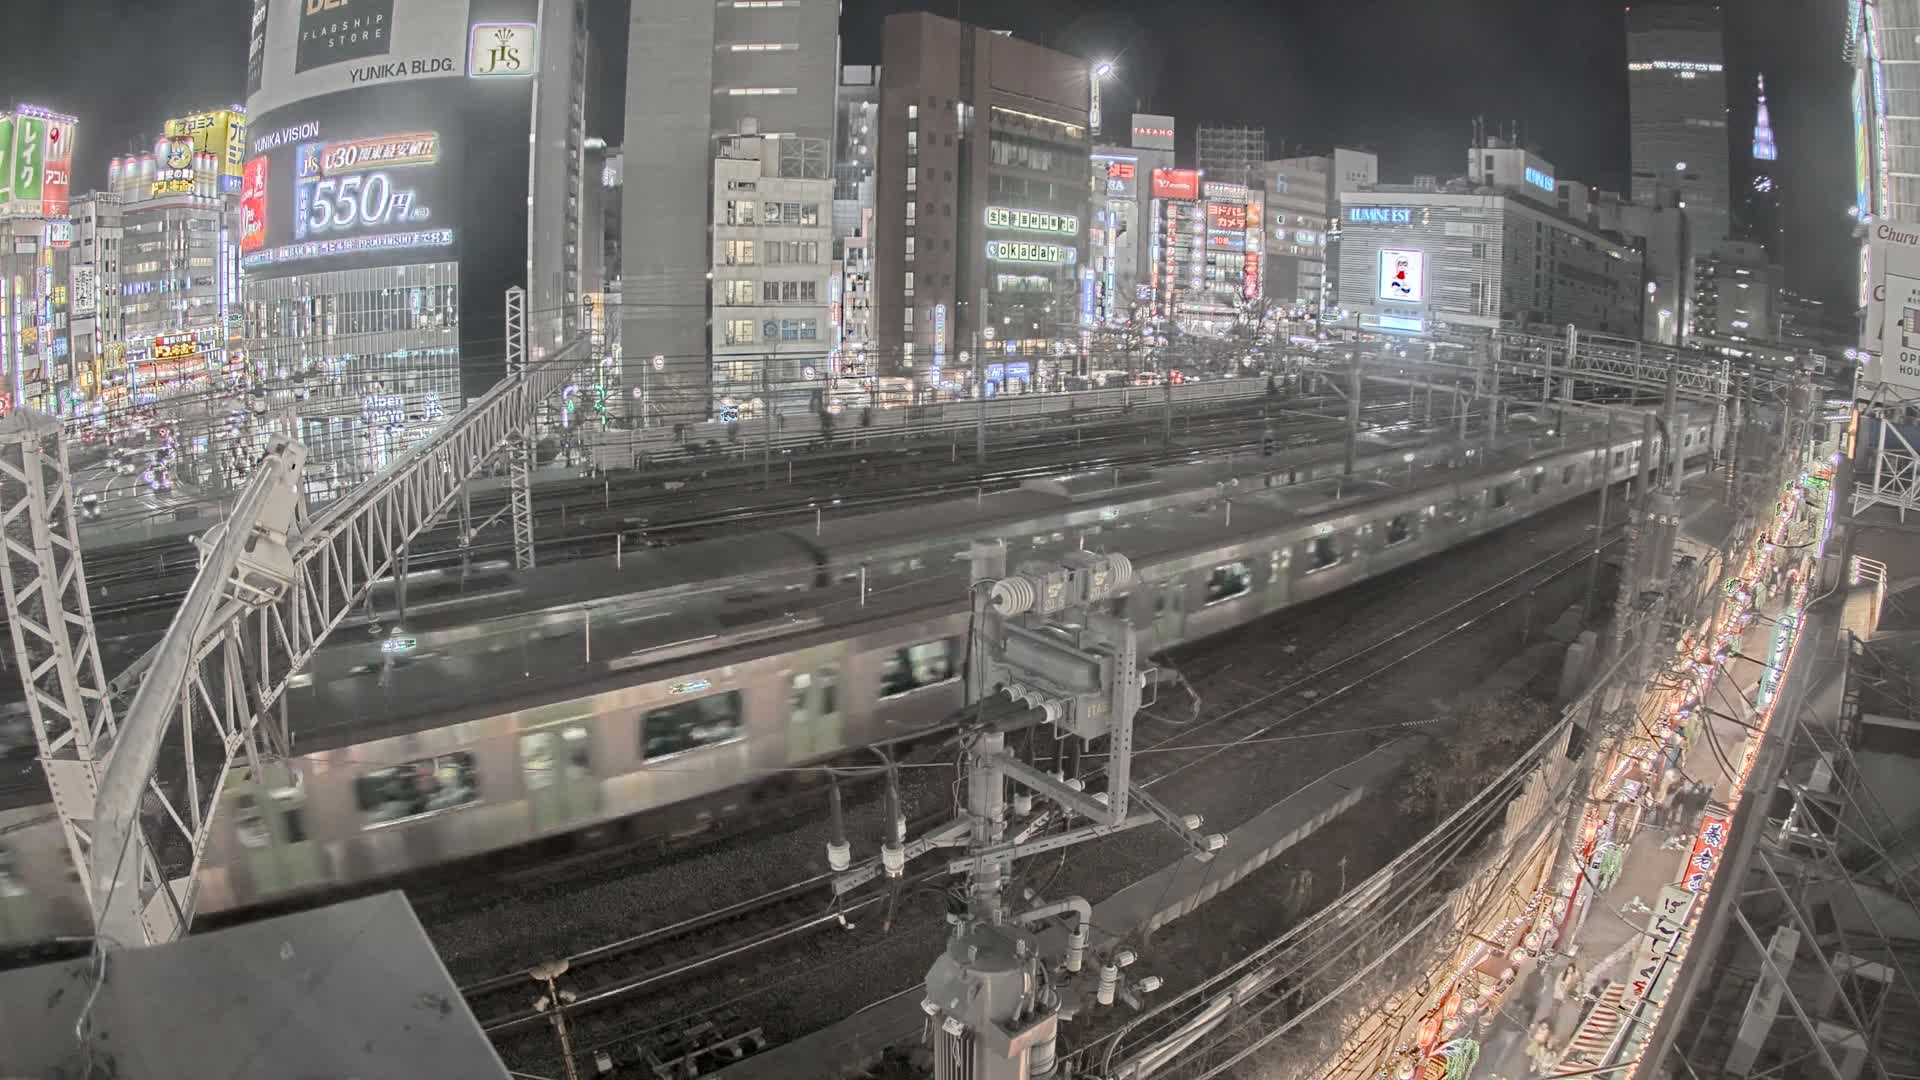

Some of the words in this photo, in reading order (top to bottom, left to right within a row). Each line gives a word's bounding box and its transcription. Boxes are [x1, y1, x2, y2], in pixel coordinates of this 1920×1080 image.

[303, 14, 383, 40] FLAGSHIP
[328, 28, 382, 47] STORE
[350, 63, 408, 83] YUNIKA
[411, 58, 456, 74] BLDG.
[255, 132, 281, 153] YUNIKA
[283, 121, 320, 144] VISION
[1134, 127, 1174, 137] TAKANO
[21, 121, 37, 188] レイク
[45, 169, 68, 185] アコム
[1208, 205, 1246, 217] ヨドバシ
[1350, 208, 1391, 223] LUMINE
[1391, 209, 1410, 223] EST
[1217, 218, 1246, 229] カメラ
[365, 395, 405, 407] Alpen
